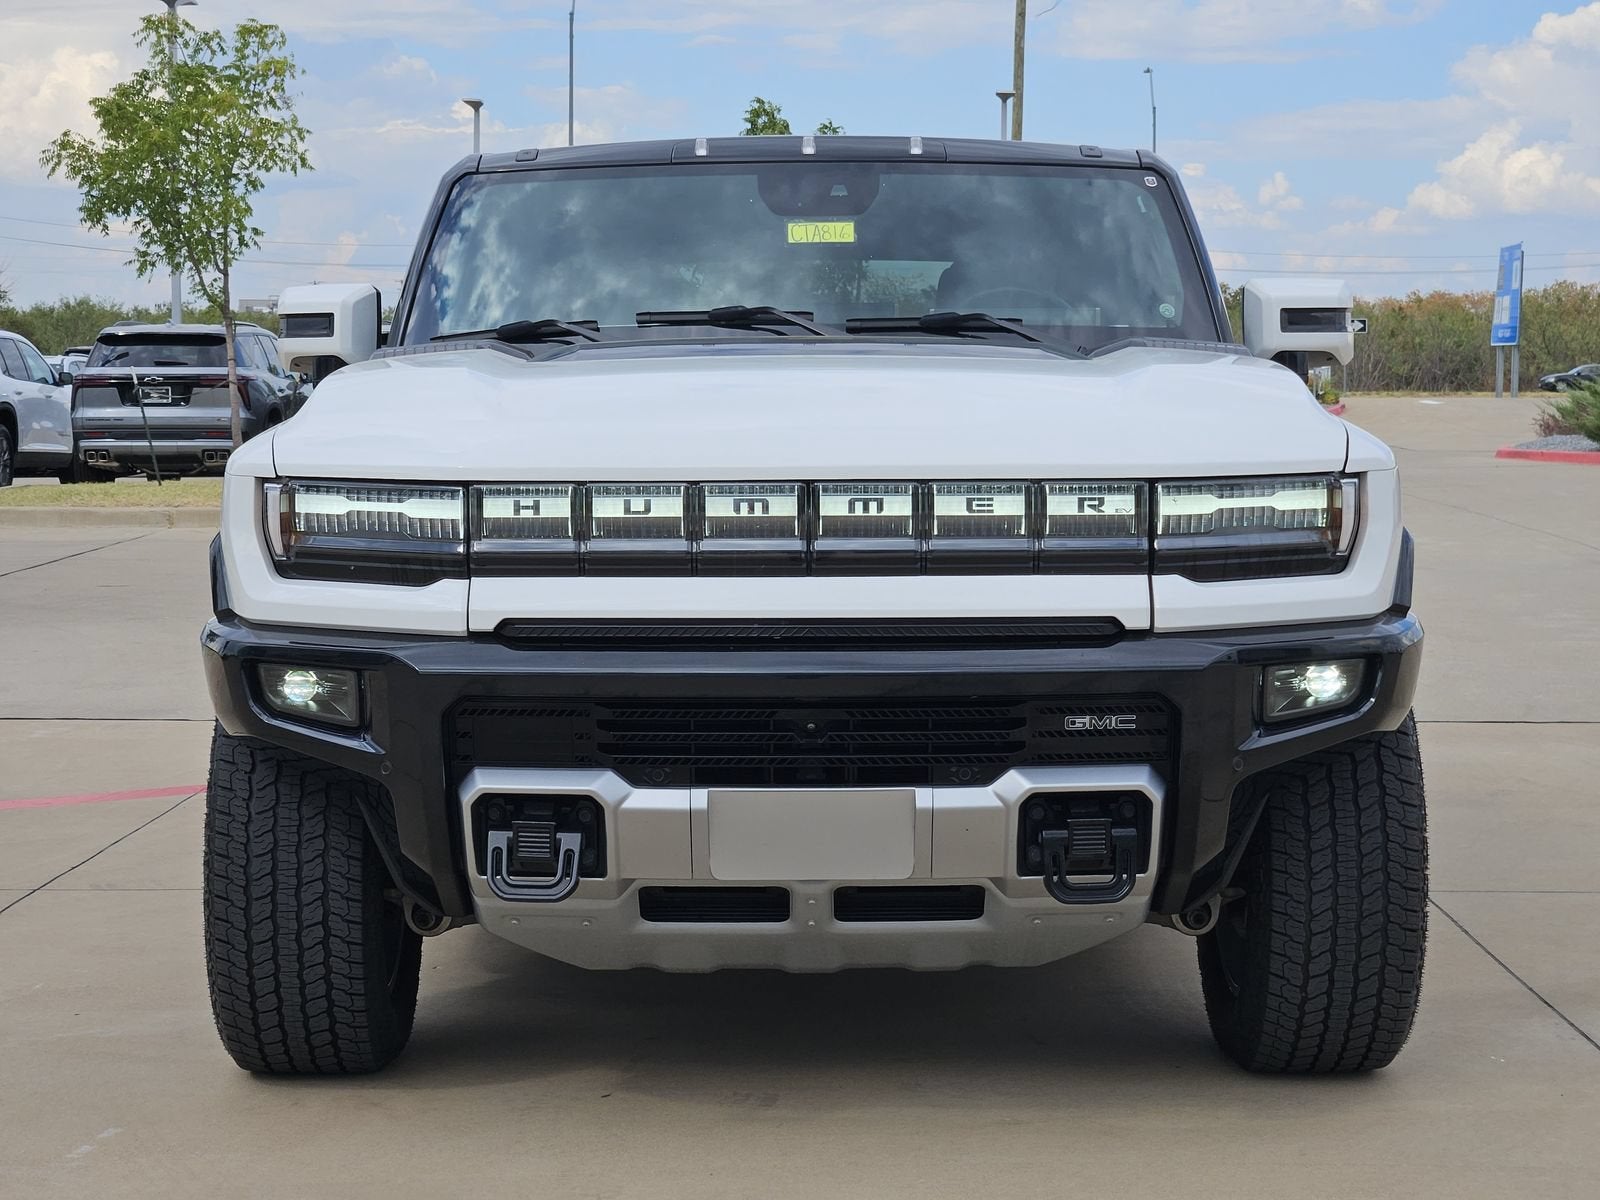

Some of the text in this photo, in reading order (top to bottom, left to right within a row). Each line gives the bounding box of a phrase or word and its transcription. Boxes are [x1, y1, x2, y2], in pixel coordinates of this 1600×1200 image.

[790, 223, 851, 242] CTA816
[513, 497, 1106, 517] HUMMER
[1064, 714, 1137, 730] GMC
